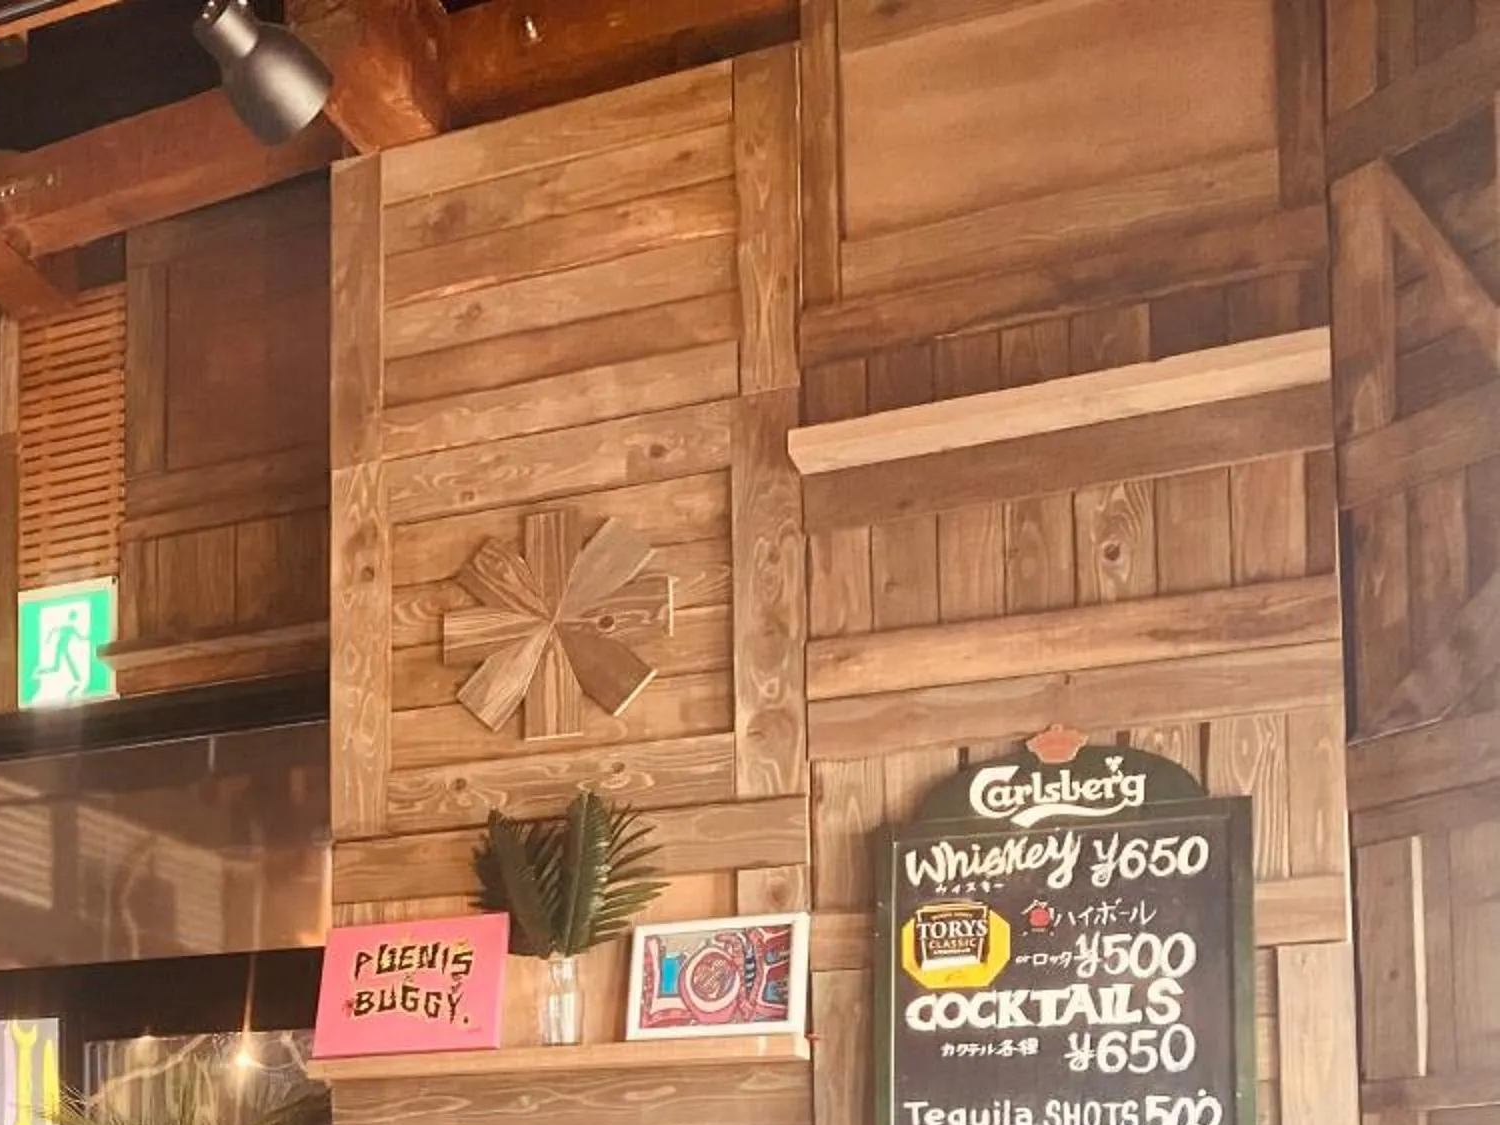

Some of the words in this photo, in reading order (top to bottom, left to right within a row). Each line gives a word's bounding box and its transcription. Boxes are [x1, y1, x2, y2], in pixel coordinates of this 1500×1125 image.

[970, 759, 1146, 819] Carlsberg
[905, 830, 1081, 888] Whiskey
[1092, 836, 1209, 887] ¥650
[917, 919, 988, 939] TORYS
[928, 938, 977, 949] CLASSIC
[354, 941, 475, 981] PUENIS
[1073, 933, 1197, 979] ¥500
[905, 978, 1183, 1032] COCKTAILS
[1064, 1024, 1195, 1074] ¥650
